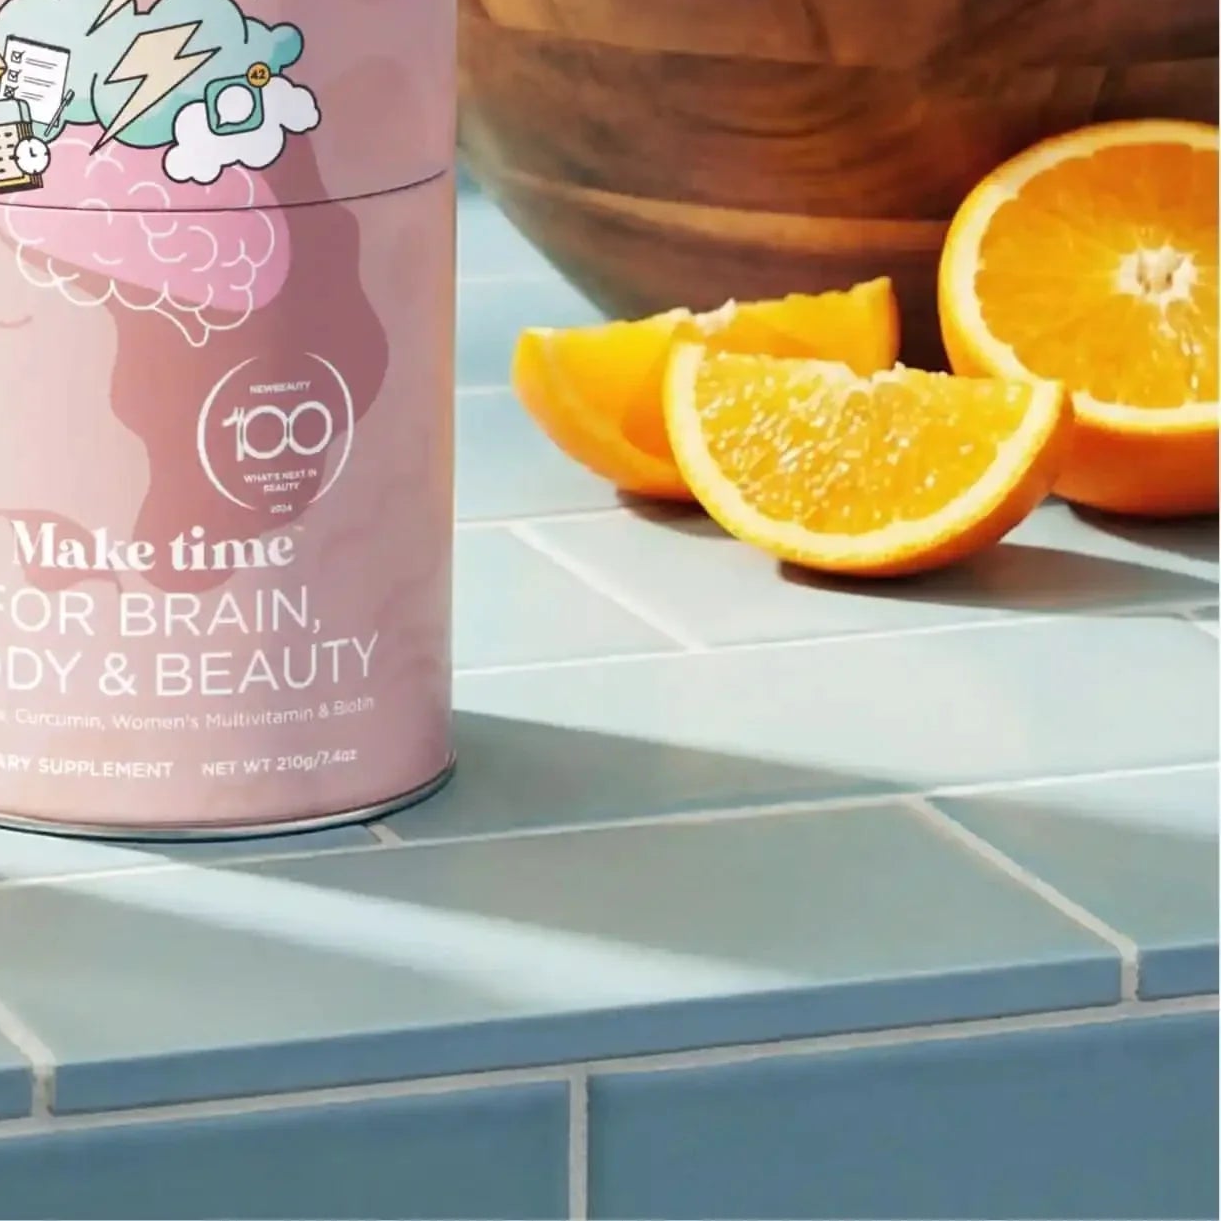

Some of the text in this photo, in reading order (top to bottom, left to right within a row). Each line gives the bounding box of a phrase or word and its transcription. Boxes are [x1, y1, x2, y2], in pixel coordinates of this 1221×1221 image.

[249, 381, 311, 394] NEWBEAUTY
[222, 400, 333, 462] 100
[263, 482, 299, 494] BEAUTY
[282, 470, 307, 481] NEXT
[308, 468, 317, 477] IN
[11, 520, 156, 571] Make
[120, 585, 321, 637] BRAIN,
[98, 652, 137, 696] &
[155, 632, 379, 697] BEAUTY
[15, 708, 106, 731] Curcumin,
[112, 714, 199, 731] Women's
[205, 707, 314, 729] Multivitamin
[318, 702, 329, 719] &
[333, 696, 375, 716] Biotin
[38, 756, 174, 779] SUPPLEMENT
[202, 760, 238, 777] NET
[243, 757, 273, 775] WT
